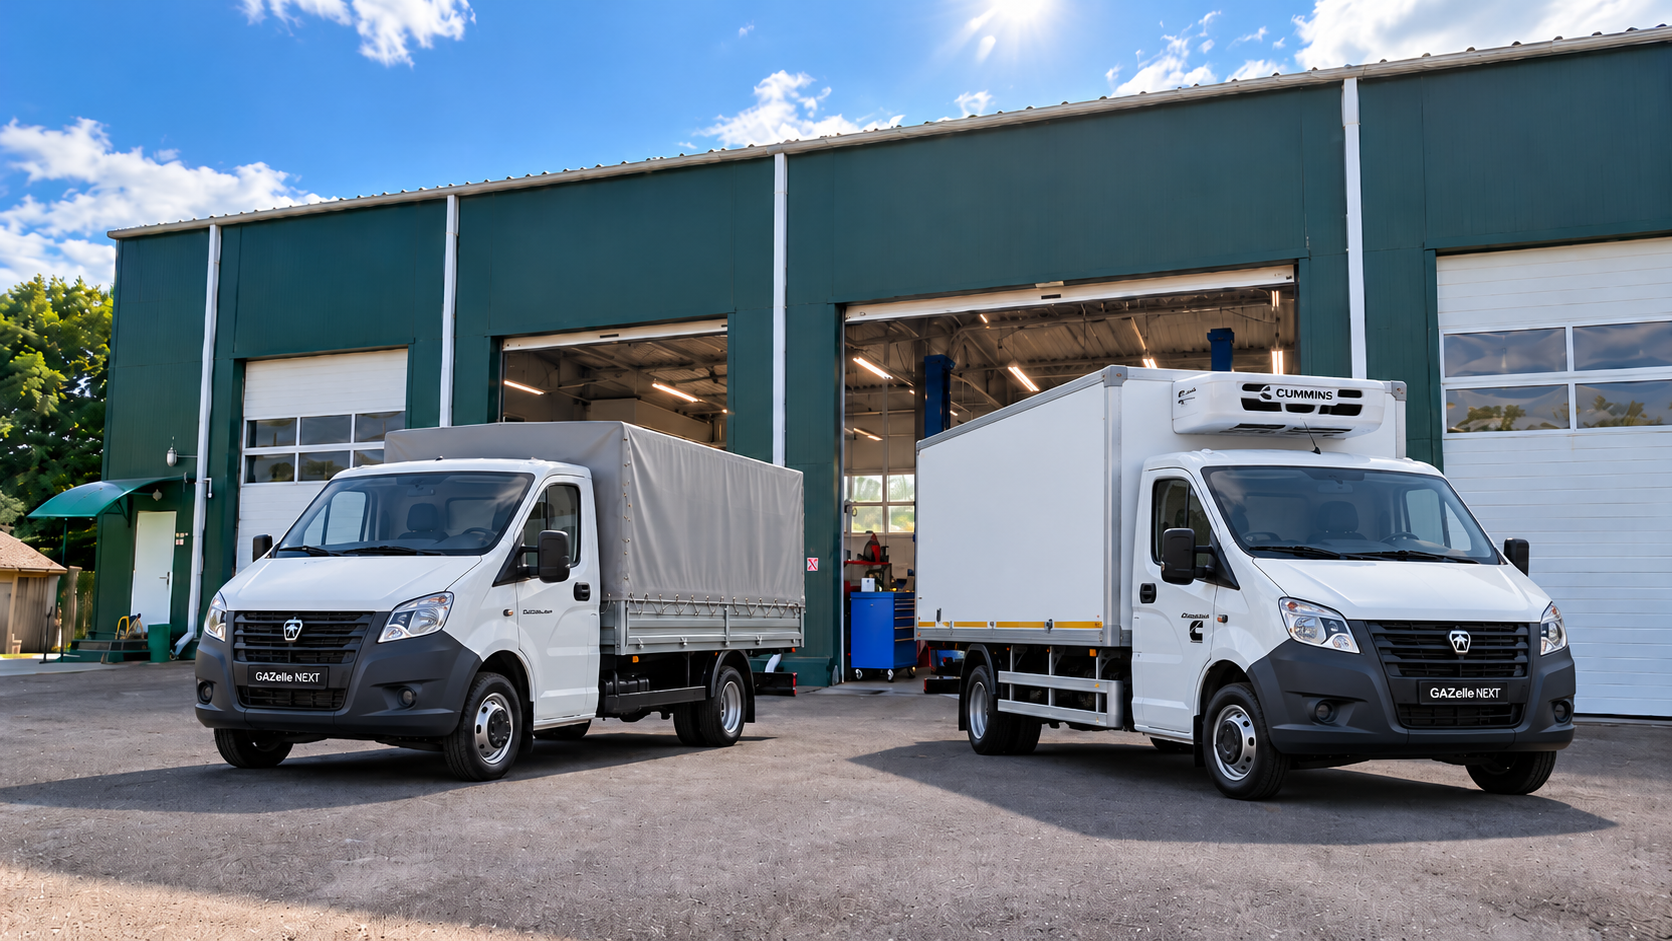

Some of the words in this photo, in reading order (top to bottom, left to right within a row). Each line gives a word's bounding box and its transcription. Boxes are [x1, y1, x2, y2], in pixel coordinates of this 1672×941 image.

[1276, 388, 1333, 400] CUMMINS
[255, 671, 293, 682] GAZelle
[294, 672, 321, 683] NEXT
[1430, 687, 1475, 699] GAZelle
[1475, 687, 1501, 699] NEXT
